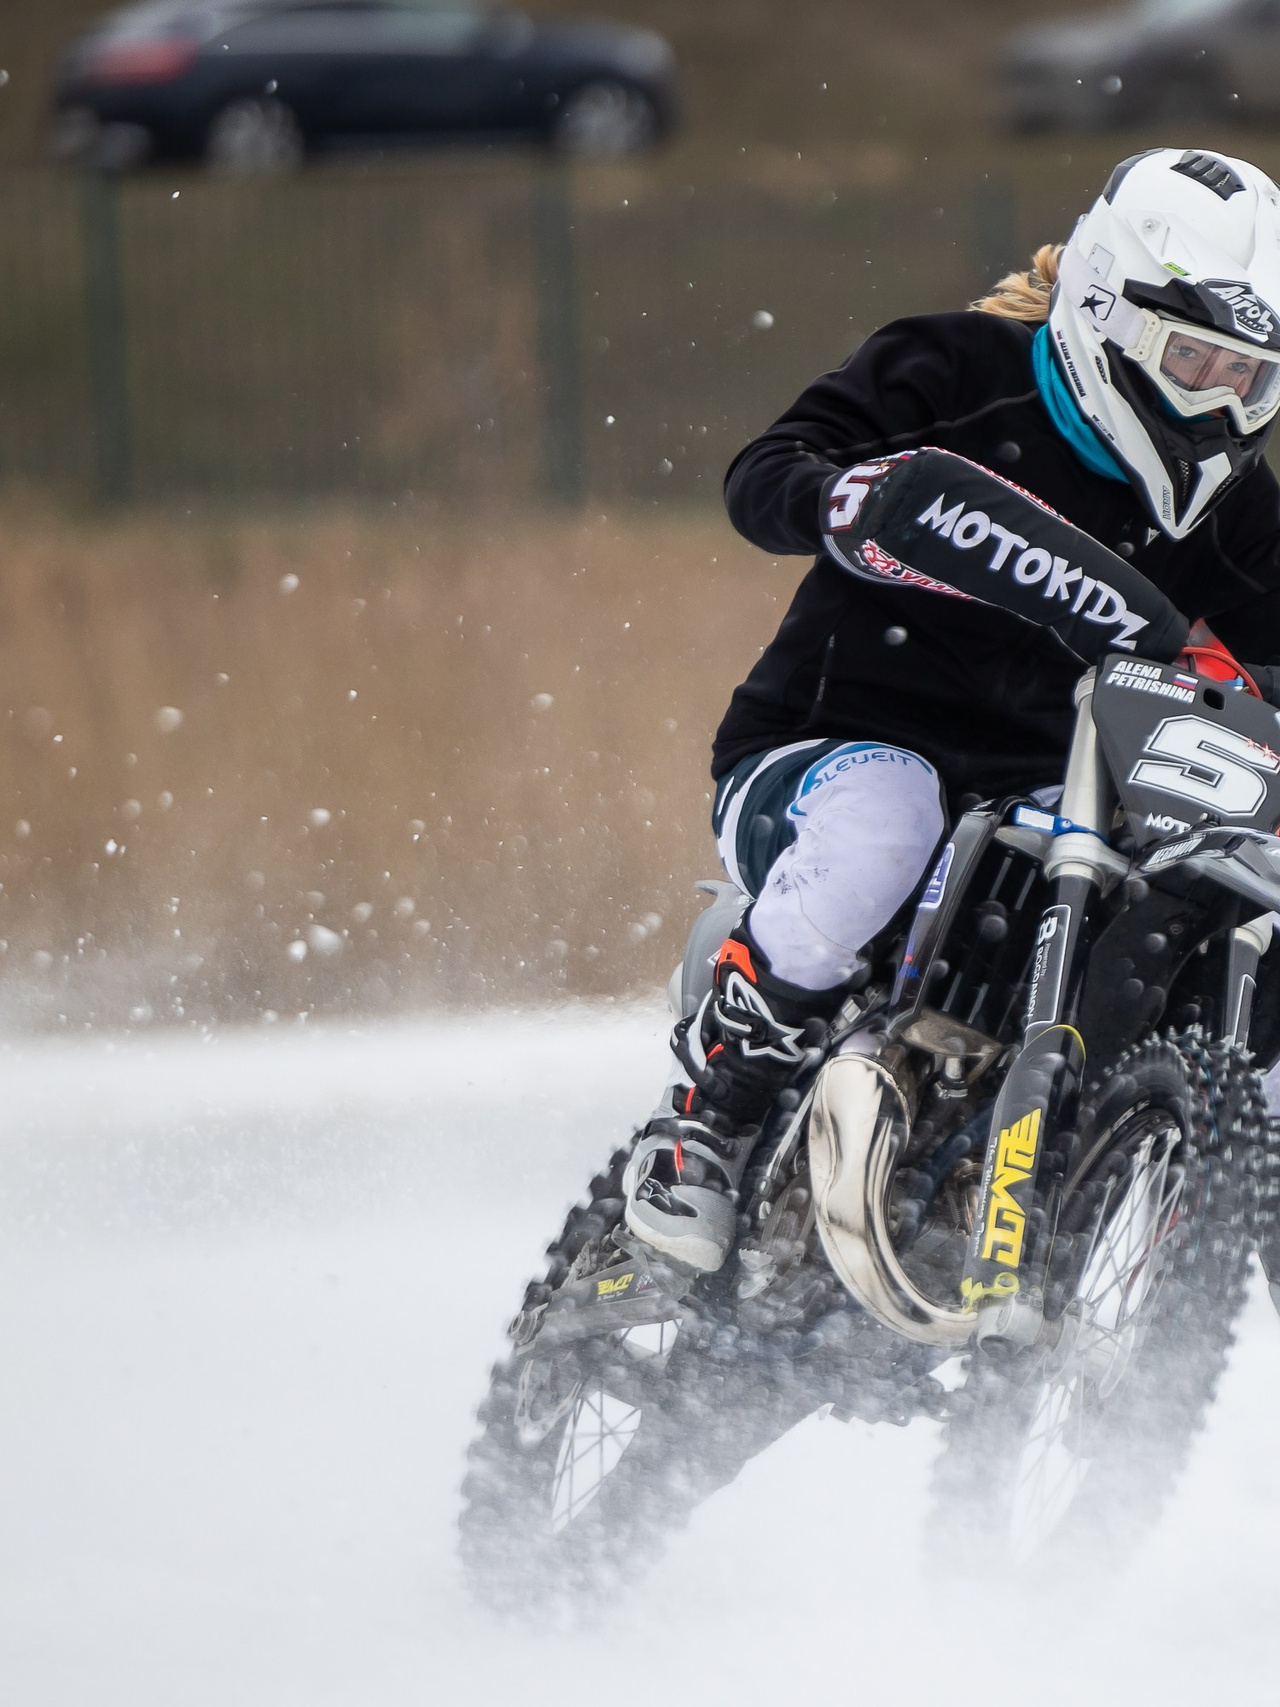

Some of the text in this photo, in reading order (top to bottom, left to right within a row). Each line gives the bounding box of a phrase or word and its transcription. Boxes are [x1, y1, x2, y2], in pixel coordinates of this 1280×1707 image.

[915, 492, 1150, 651] MOTOKIDZ
[1105, 673, 1197, 704] PETRISHINA
[1113, 660, 1163, 680] ALENA
[1127, 714, 1280, 818] 5
